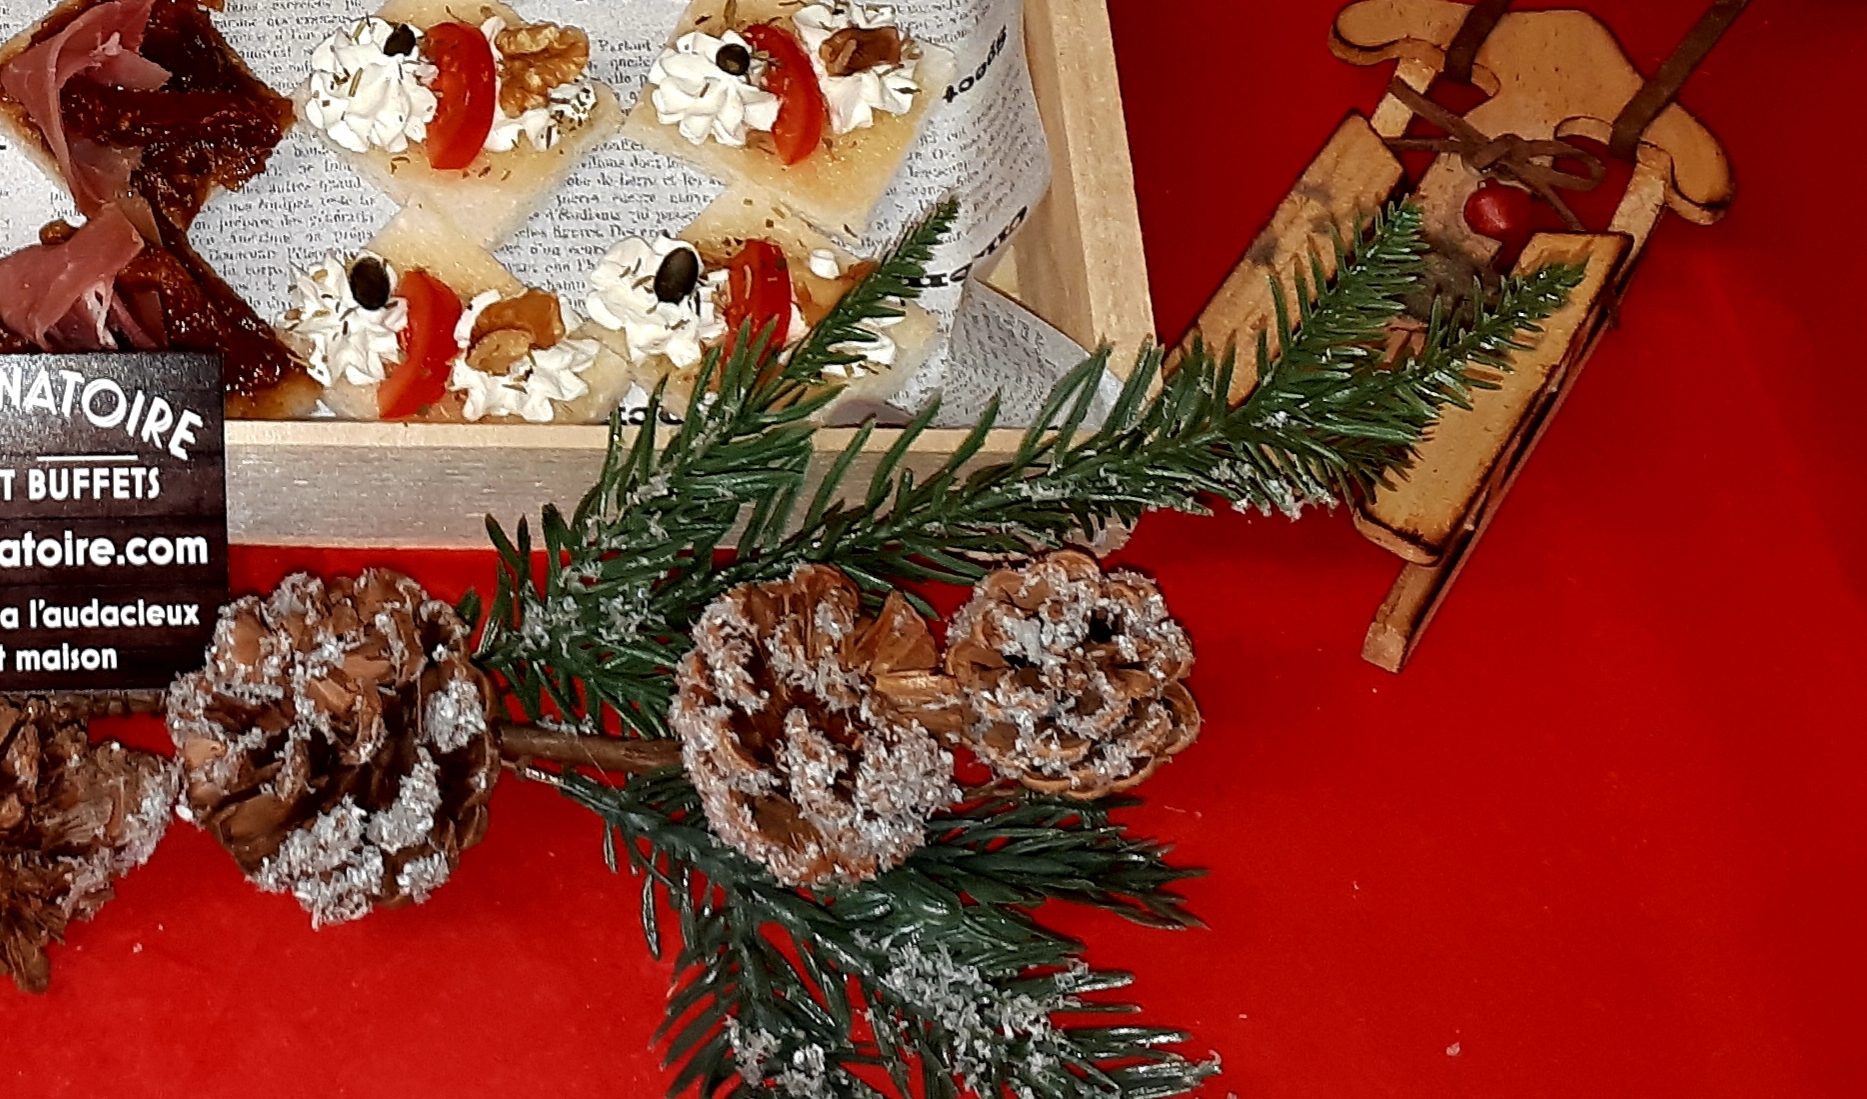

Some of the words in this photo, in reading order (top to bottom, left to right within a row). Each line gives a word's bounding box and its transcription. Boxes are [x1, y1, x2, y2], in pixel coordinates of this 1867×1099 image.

[30, 465, 162, 502] BUFFETS
[0, 607, 20, 630] a
[29, 596, 201, 631] l'audacieux
[16, 642, 119, 673] maison
